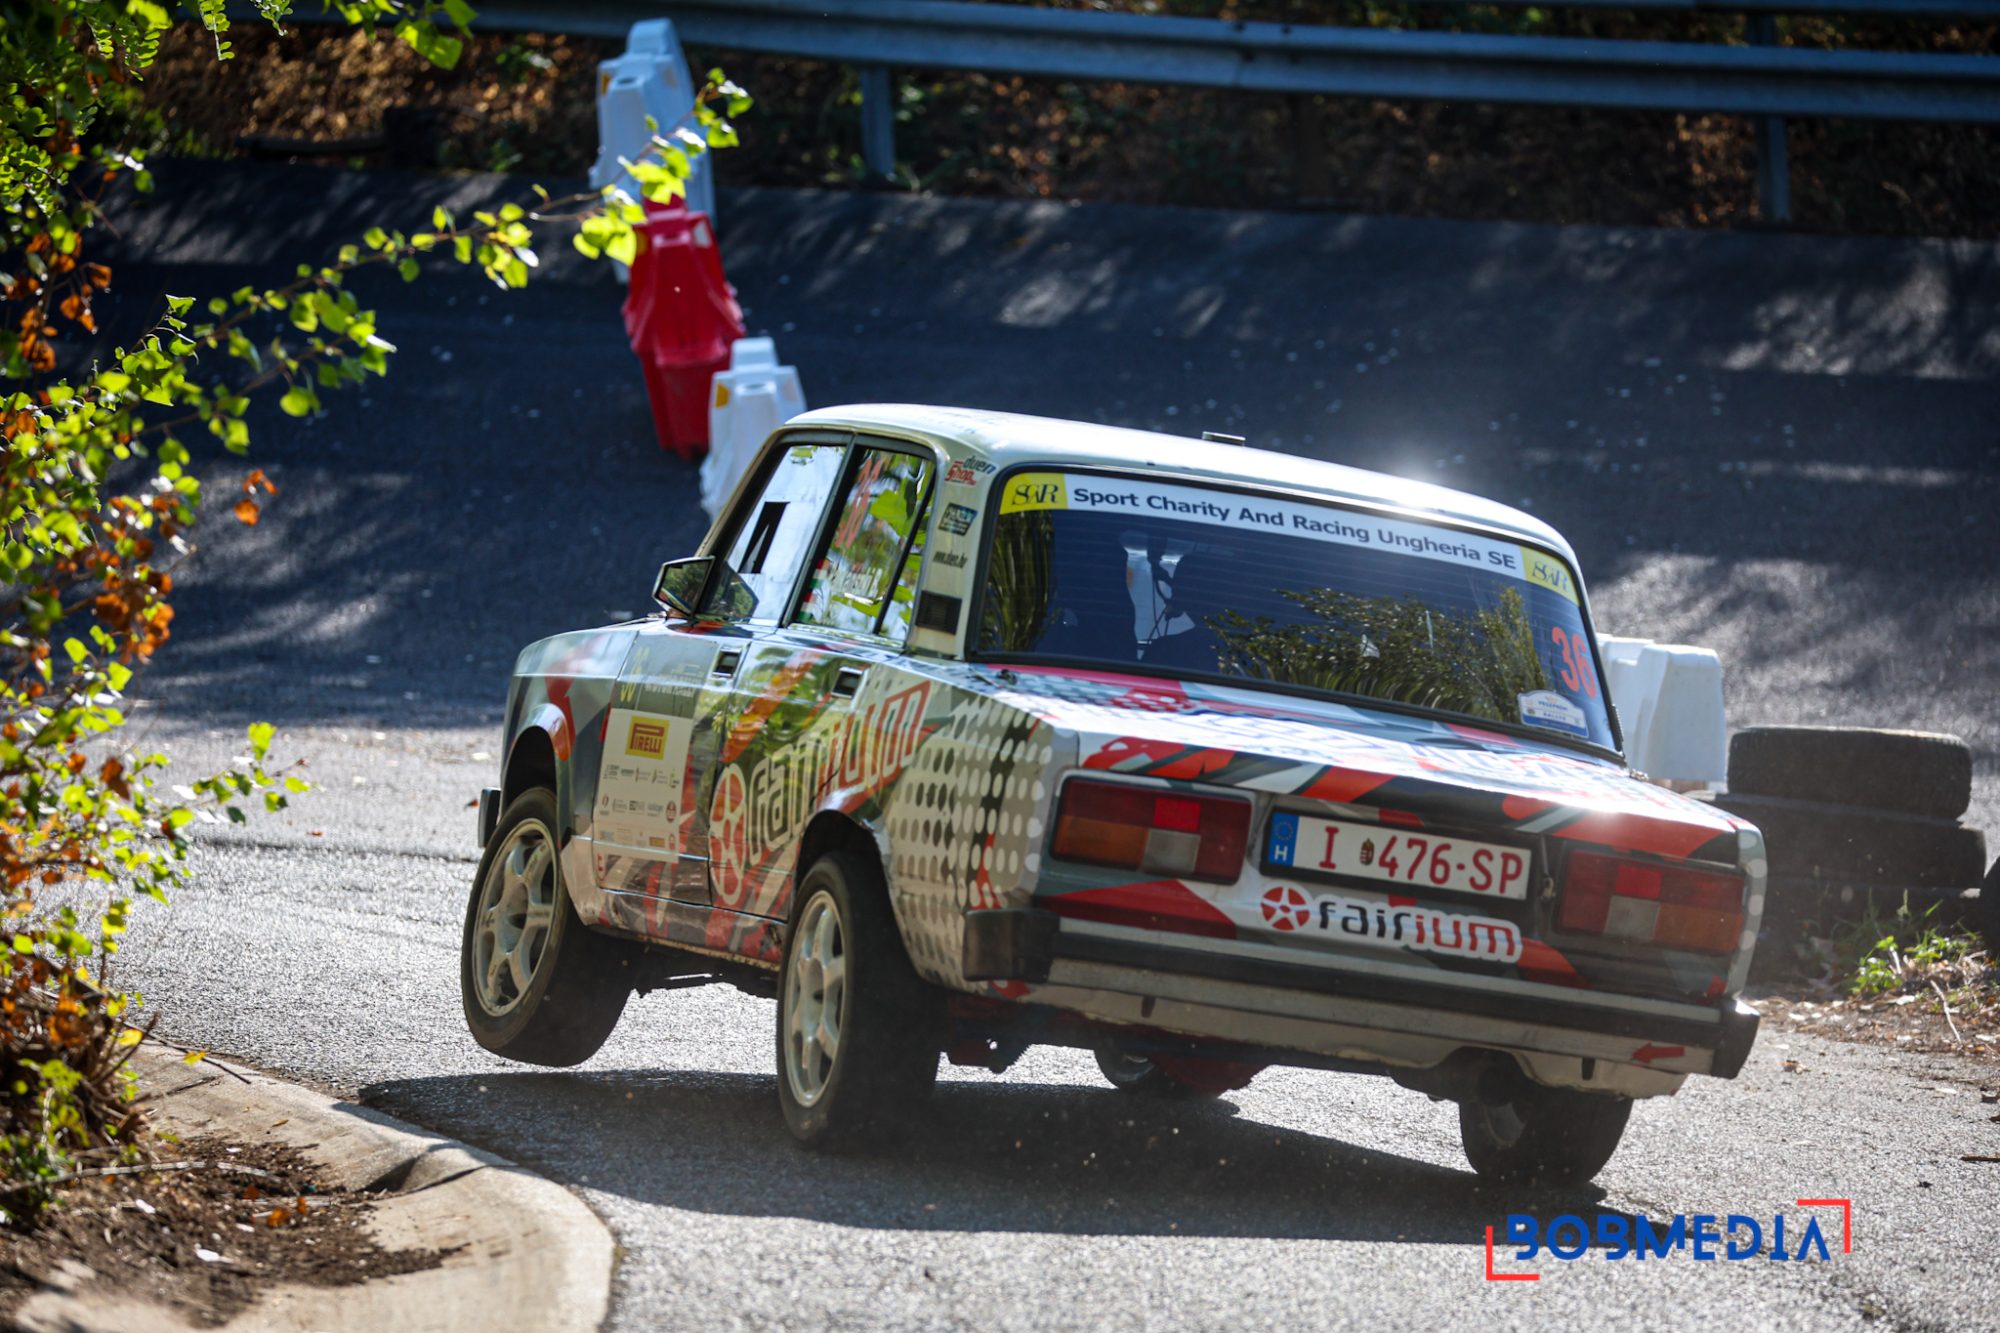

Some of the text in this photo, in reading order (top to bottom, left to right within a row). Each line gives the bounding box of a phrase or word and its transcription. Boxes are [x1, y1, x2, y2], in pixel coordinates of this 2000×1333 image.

[1073, 488, 1517, 570] Sport Charity And Racing Ungheria SE
[1551, 626, 1598, 699] 36
[630, 722, 665, 754] PIRELLI
[1274, 844, 1288, 862] H
[1318, 825, 1340, 870] I
[1319, 901, 1516, 956] fairium
